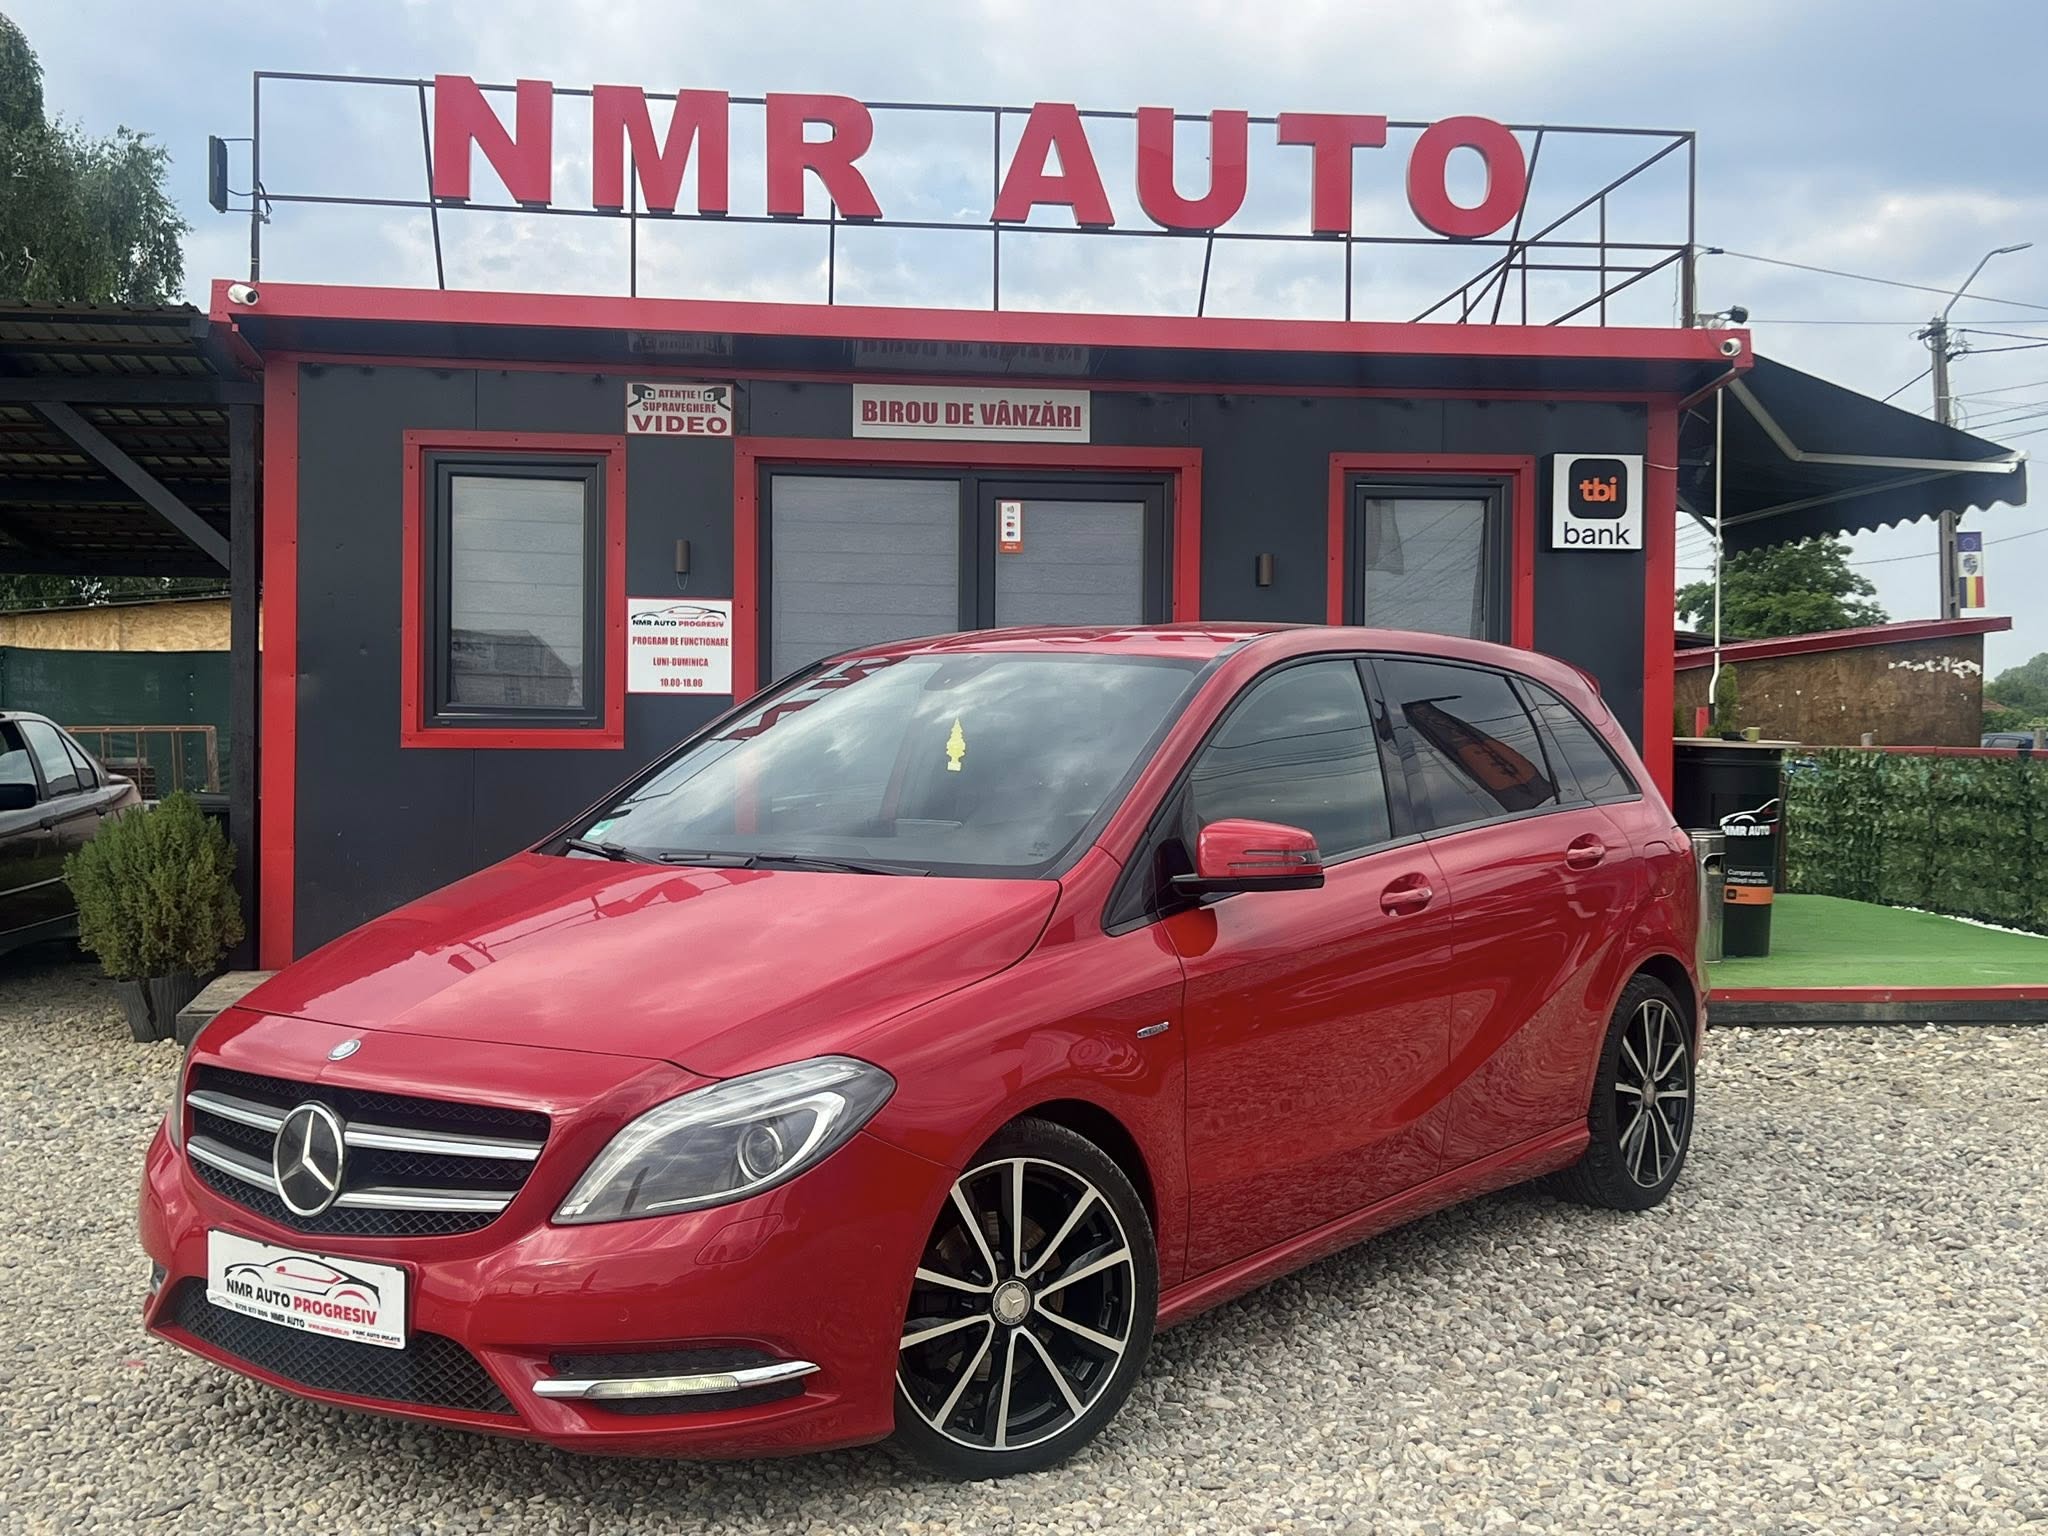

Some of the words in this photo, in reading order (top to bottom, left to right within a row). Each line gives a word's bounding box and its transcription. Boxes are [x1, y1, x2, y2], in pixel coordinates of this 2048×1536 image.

[433, 75, 883, 219] NMR
[992, 102, 1526, 239] AUTO
[642, 402, 716, 413] SUPRAVEGHERE
[862, 400, 938, 424] BIROU
[945, 402, 974, 425] DE
[980, 400, 1082, 427] VÂNZĂRI
[632, 415, 727, 434] VIDEO
[1579, 476, 1617, 502] tbi
[1564, 521, 1630, 545] bank
[632, 619, 652, 627] NMR
[678, 620, 724, 628] PROGRESIV
[632, 636, 668, 645] PROGRAM
[670, 637, 679, 646] DE
[680, 638, 729, 647] FUNCTIONARE
[653, 657, 709, 667] LUNI-DUMINICA
[660, 678, 703, 688] 10.00-18.00
[1748, 825, 1770, 836] AUTO
[226, 1278, 253, 1299] NMR
[256, 1287, 290, 1308] AUTO
[293, 1296, 377, 1325] PROGRESIV
[286, 1315, 305, 1328] AUTO
